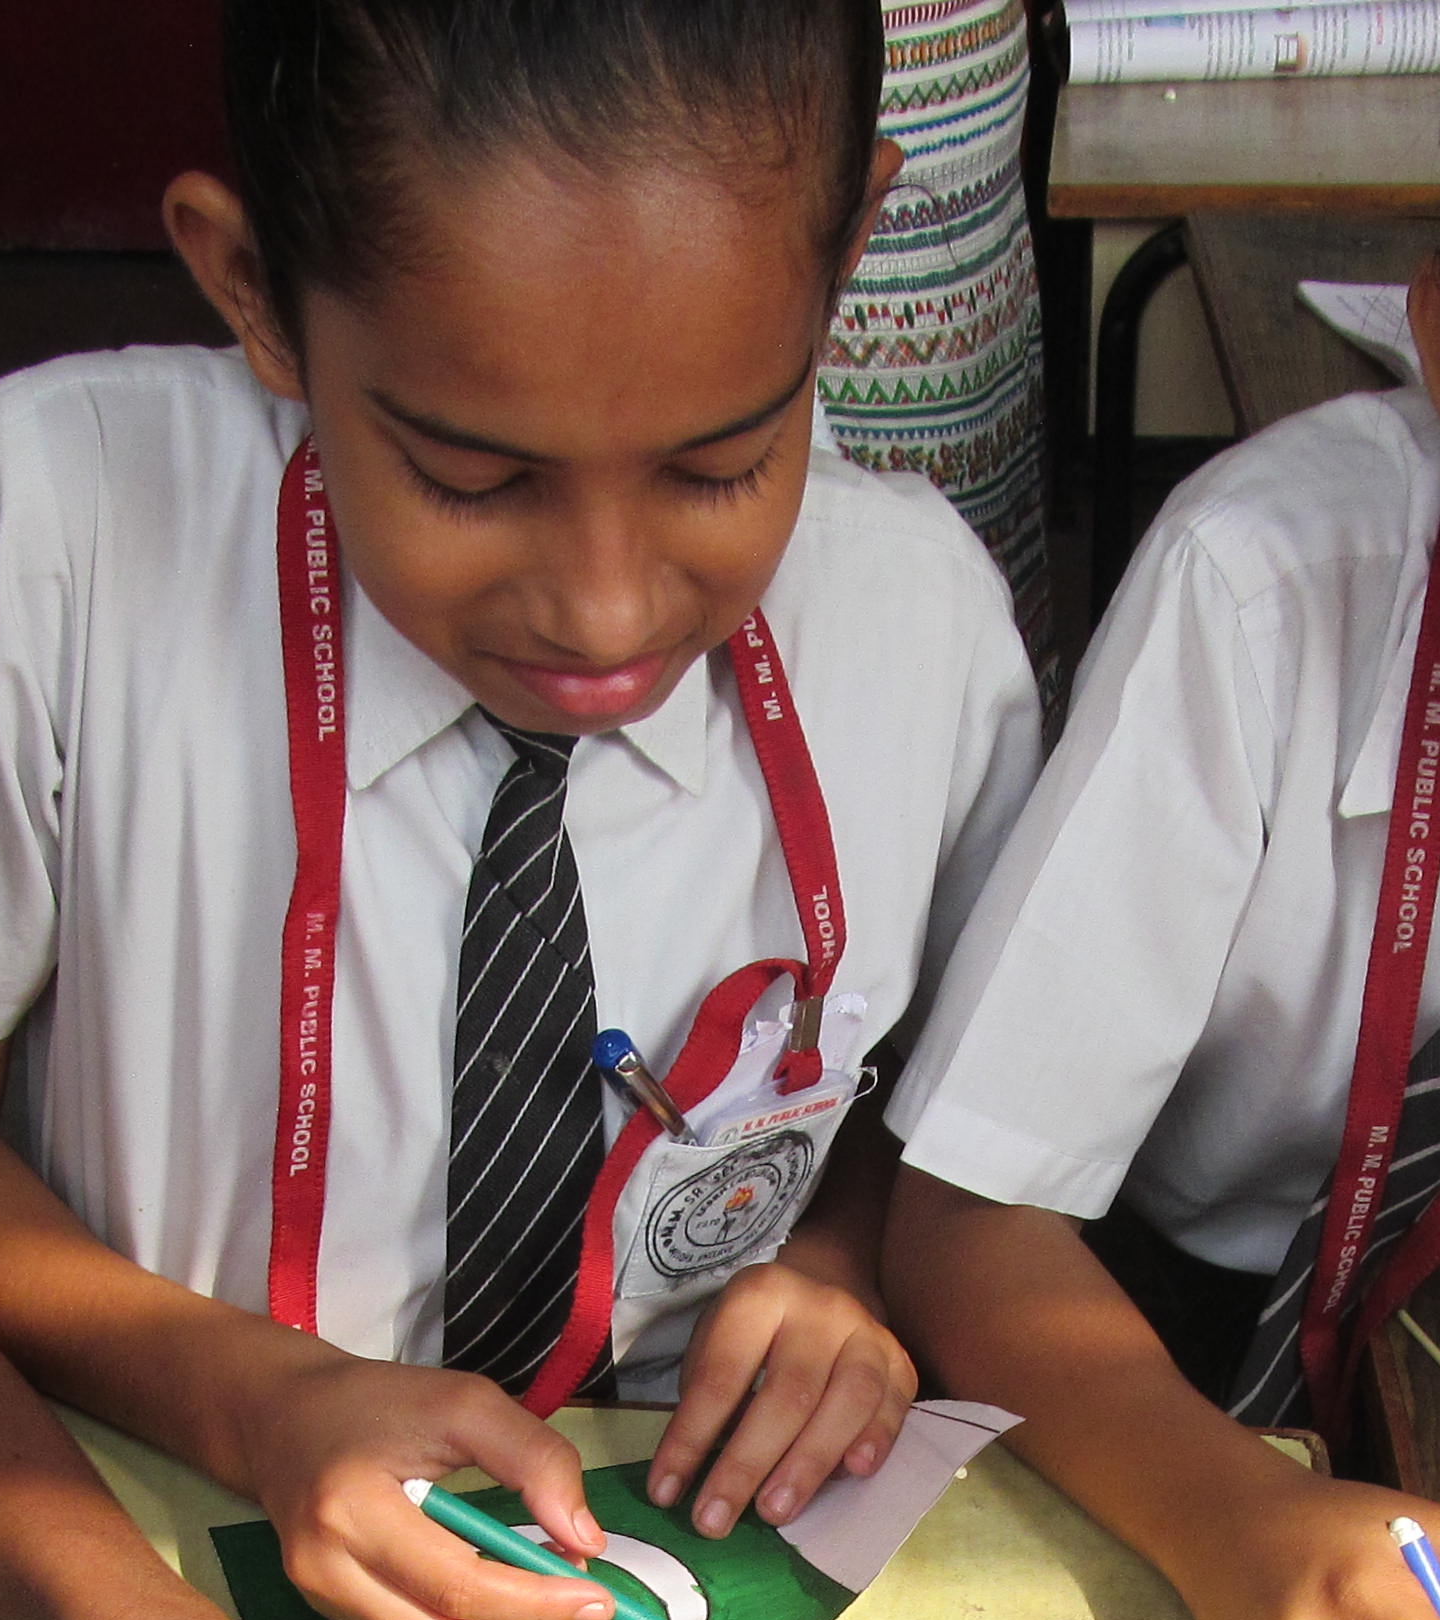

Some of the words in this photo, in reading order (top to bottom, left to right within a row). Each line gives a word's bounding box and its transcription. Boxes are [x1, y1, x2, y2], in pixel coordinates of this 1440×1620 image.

[304, 469, 324, 500] M.
[306, 509, 331, 615] PUBLIC
[311, 624, 337, 742] SCHOOL
[754, 654, 773, 684] M.
[763, 691, 783, 720] M.
[1410, 740, 1440, 840] PUBLIC
[306, 912, 325, 941] M.
[1392, 848, 1425, 954] SCHOOL
[304, 948, 322, 978] M.
[299, 985, 320, 1077] PUBLIC
[290, 1083, 316, 1178] SCHOOL
[1362, 1154, 1382, 1172] M.
[1368, 1125, 1389, 1149] M.
[1344, 1176, 1376, 1245] PUBLIC
[1323, 1245, 1357, 1313] SCHOOL
